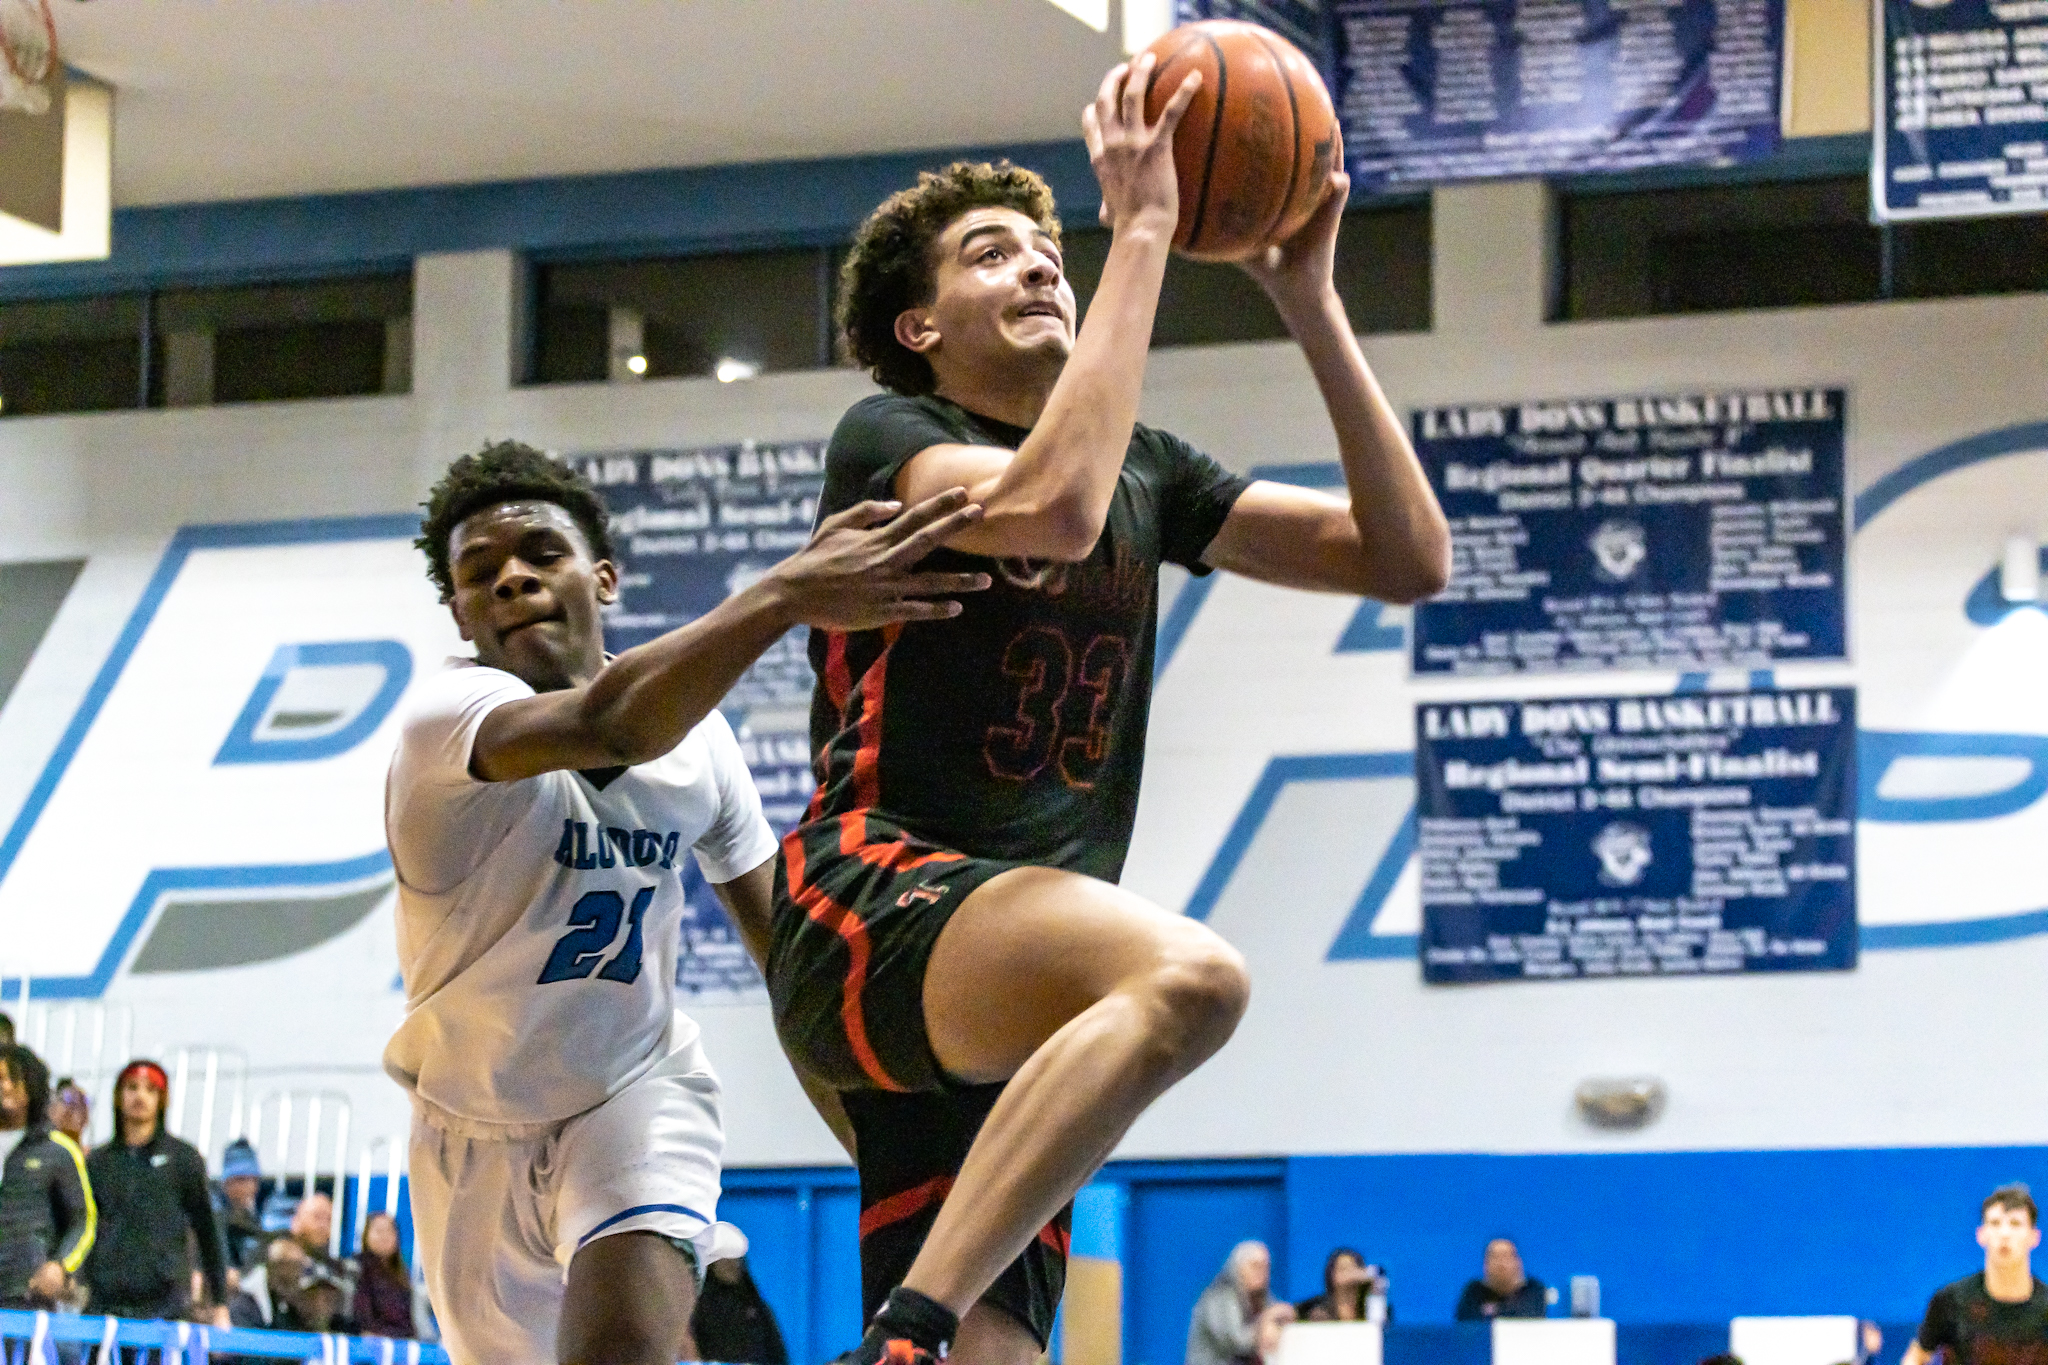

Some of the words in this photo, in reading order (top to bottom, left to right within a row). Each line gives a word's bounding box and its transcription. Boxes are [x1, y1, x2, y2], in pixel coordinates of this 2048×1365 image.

[1424, 406, 1505, 439] LADY
[1520, 402, 1604, 432] DONS
[1614, 391, 1832, 428] BASKETBALL
[1445, 460, 1572, 491] Regional
[1579, 455, 1690, 483] Quarter
[983, 622, 1126, 790] 33
[1425, 706, 1510, 739] LADY
[1522, 703, 1610, 733] DONS
[1618, 694, 1839, 730] BASKETBALL
[1445, 758, 1589, 789] Regional
[540, 885, 656, 985] 21
